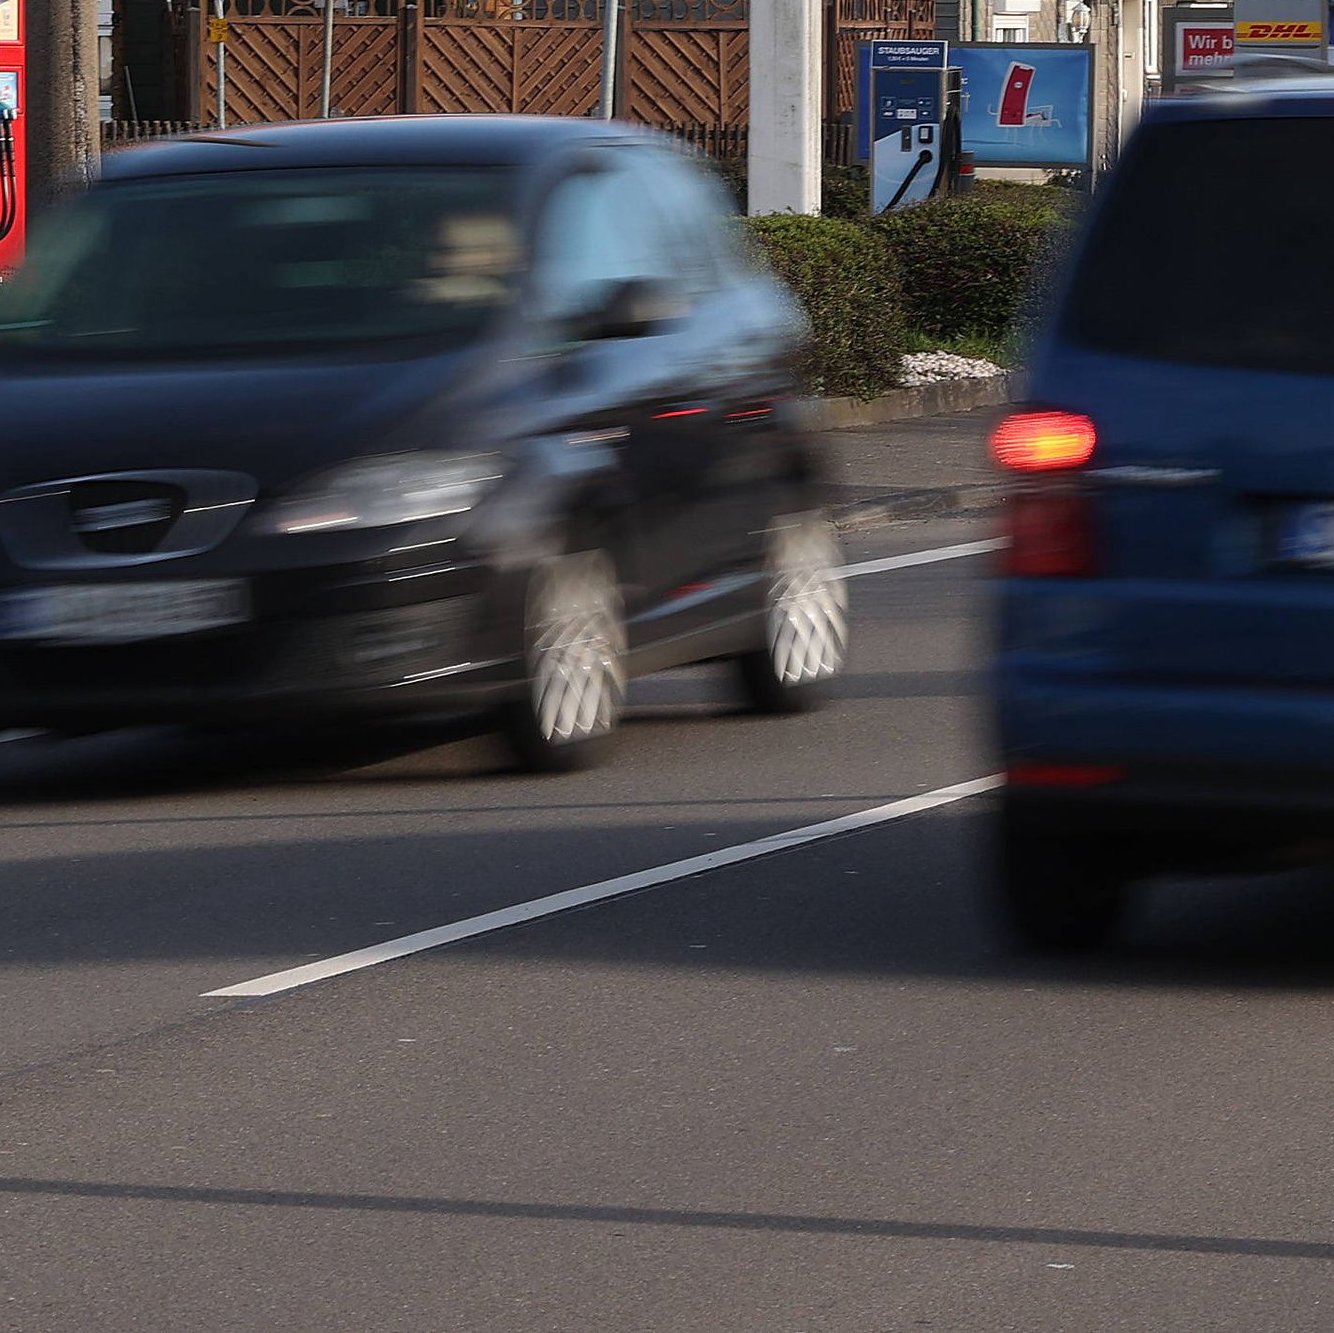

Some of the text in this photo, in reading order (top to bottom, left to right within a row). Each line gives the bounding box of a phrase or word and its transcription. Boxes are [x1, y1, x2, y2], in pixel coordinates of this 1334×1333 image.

[1249, 24, 1312, 39] DHL
[1188, 35, 1216, 49] Wir
[877, 47, 940, 55] STAUBSAUGER
